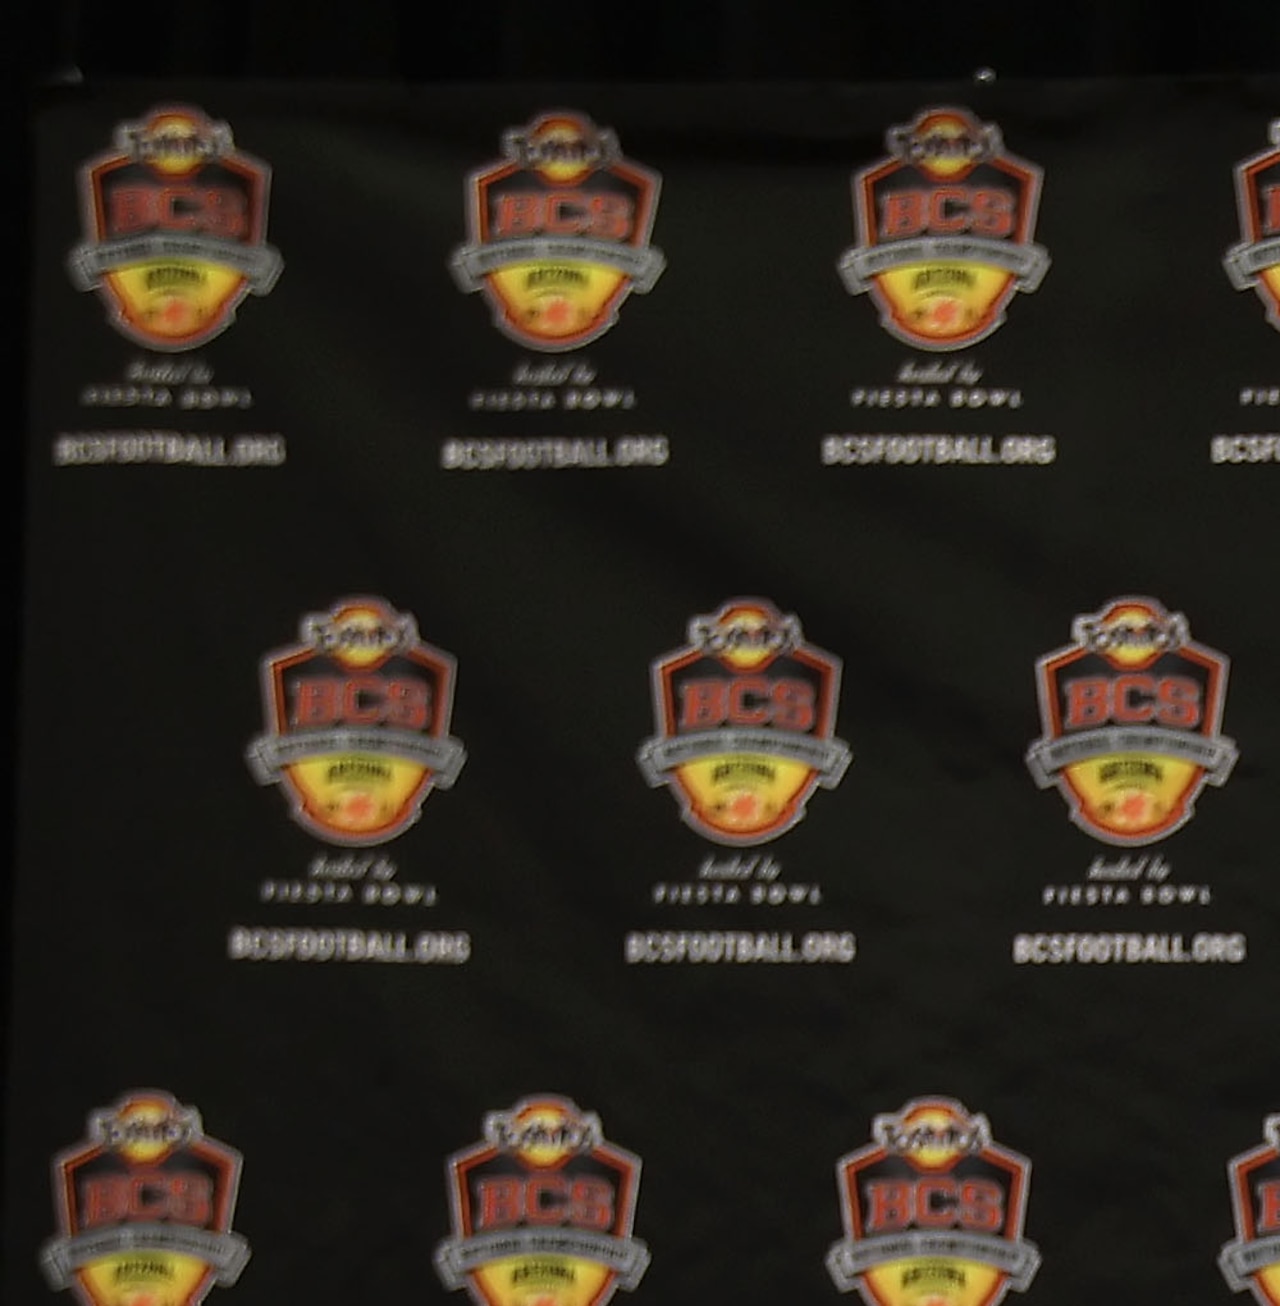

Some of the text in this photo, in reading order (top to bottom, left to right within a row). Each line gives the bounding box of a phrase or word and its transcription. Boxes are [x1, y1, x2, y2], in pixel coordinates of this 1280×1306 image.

[494, 183, 633, 240] BCS
[881, 181, 1016, 238] BCS
[821, 433, 1057, 465] BCSFOOTBALL.ORG
[681, 674, 816, 731] BCS
[1066, 671, 1202, 728] BCS
[624, 930, 857, 964] BCSFOOTBALL.ORG
[1012, 931, 1247, 964] BCSFOOTBALL.ORG
[478, 1174, 614, 1231] BCS
[869, 1175, 1004, 1232] BCS
